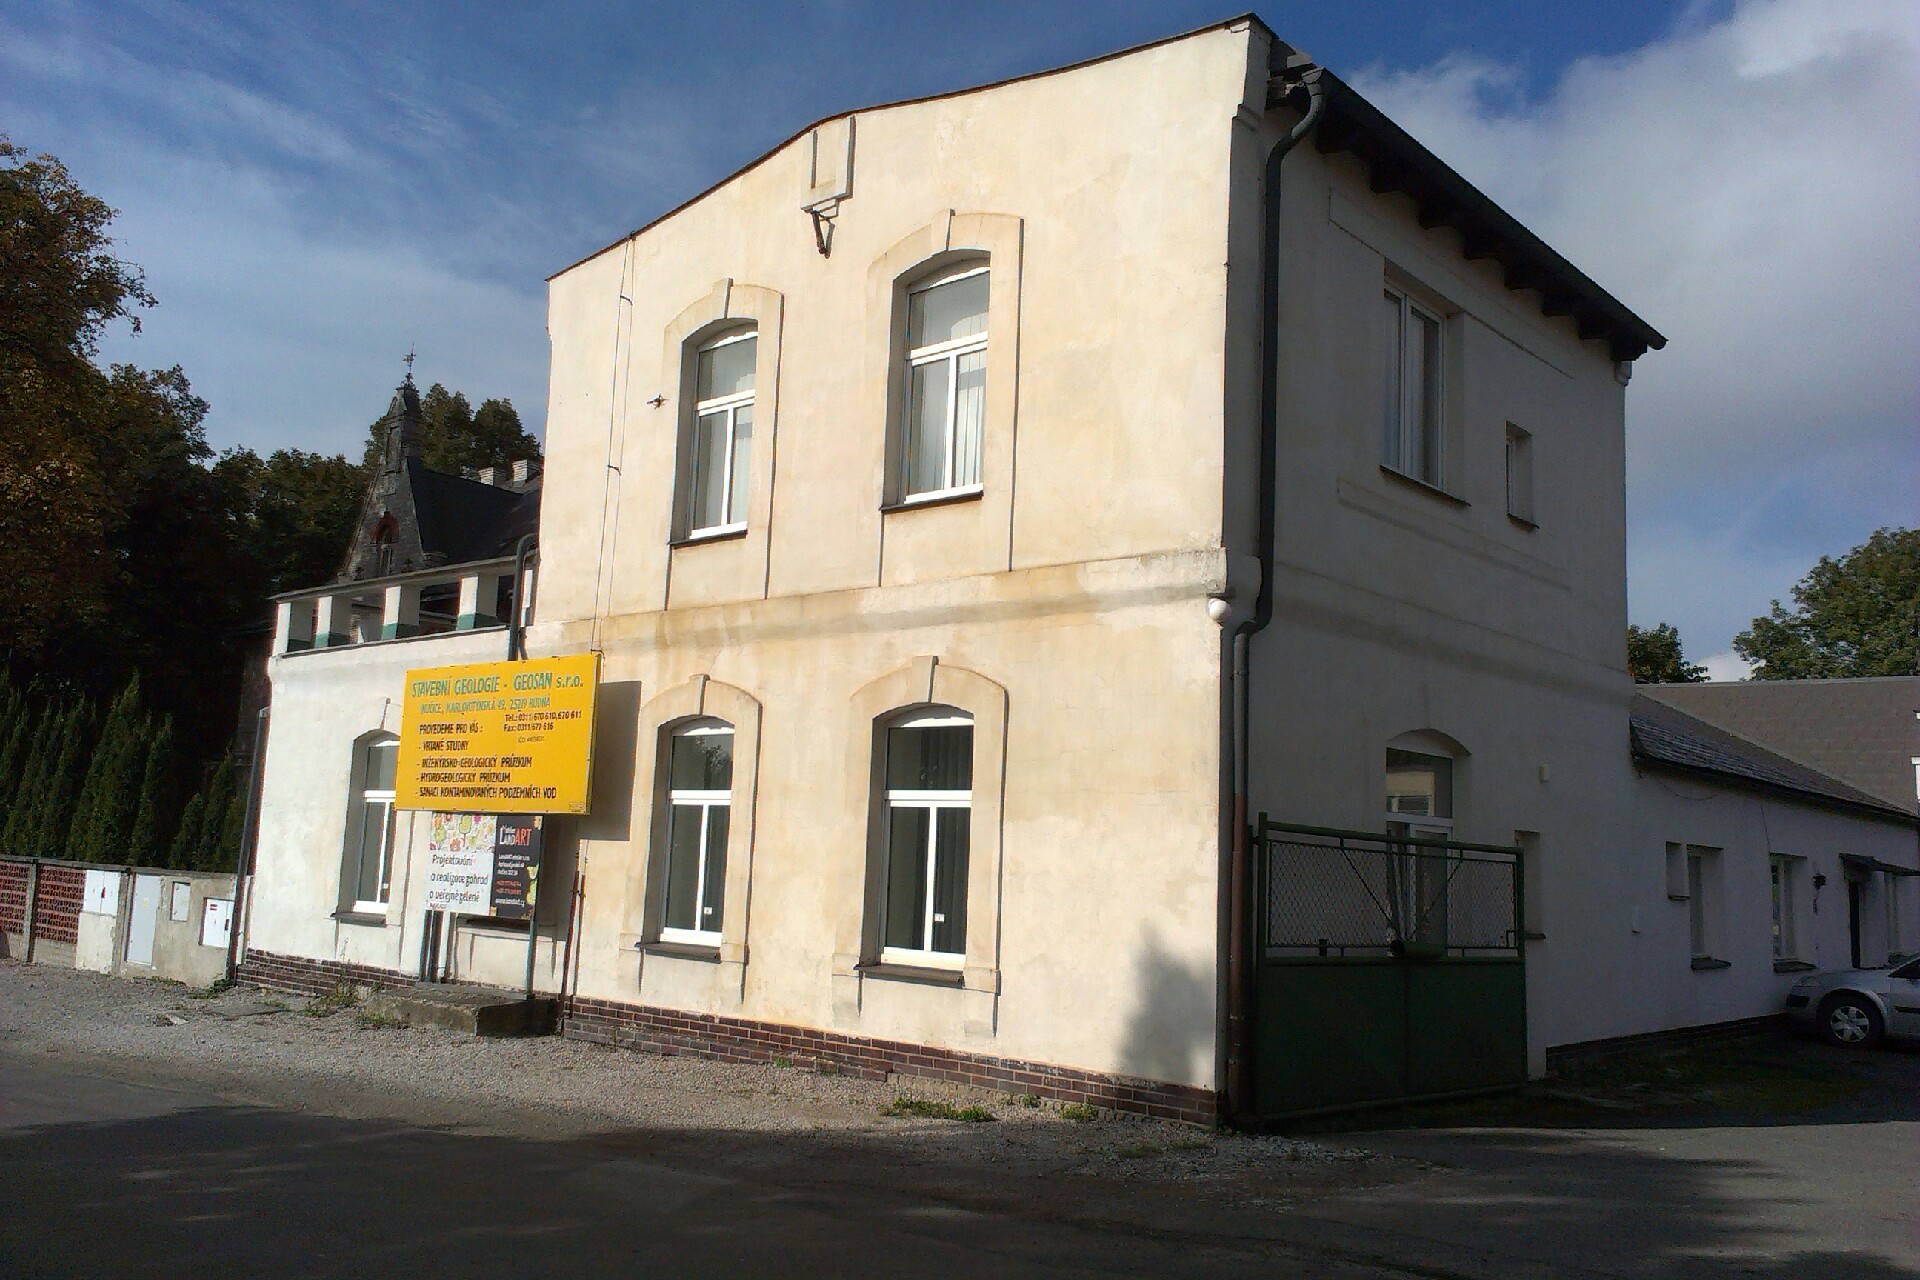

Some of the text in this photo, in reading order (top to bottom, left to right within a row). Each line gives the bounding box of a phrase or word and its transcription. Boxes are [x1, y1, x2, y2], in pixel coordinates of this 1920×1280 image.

[411, 676, 451, 697] STAVEBNÍ
[454, 676, 500, 696] GEOLOGIE
[513, 672, 553, 691] GEOSAN
[555, 675, 584, 688] s.r.o.
[419, 722, 454, 735] PROVEDEME
[456, 722, 468, 733] PRO
[446, 739, 469, 751] STUDNY
[420, 769, 476, 783] HYDROGEOLOGICKÝ
[499, 784, 541, 799] PODZEMNÍCH
[543, 786, 557, 799] VOD
